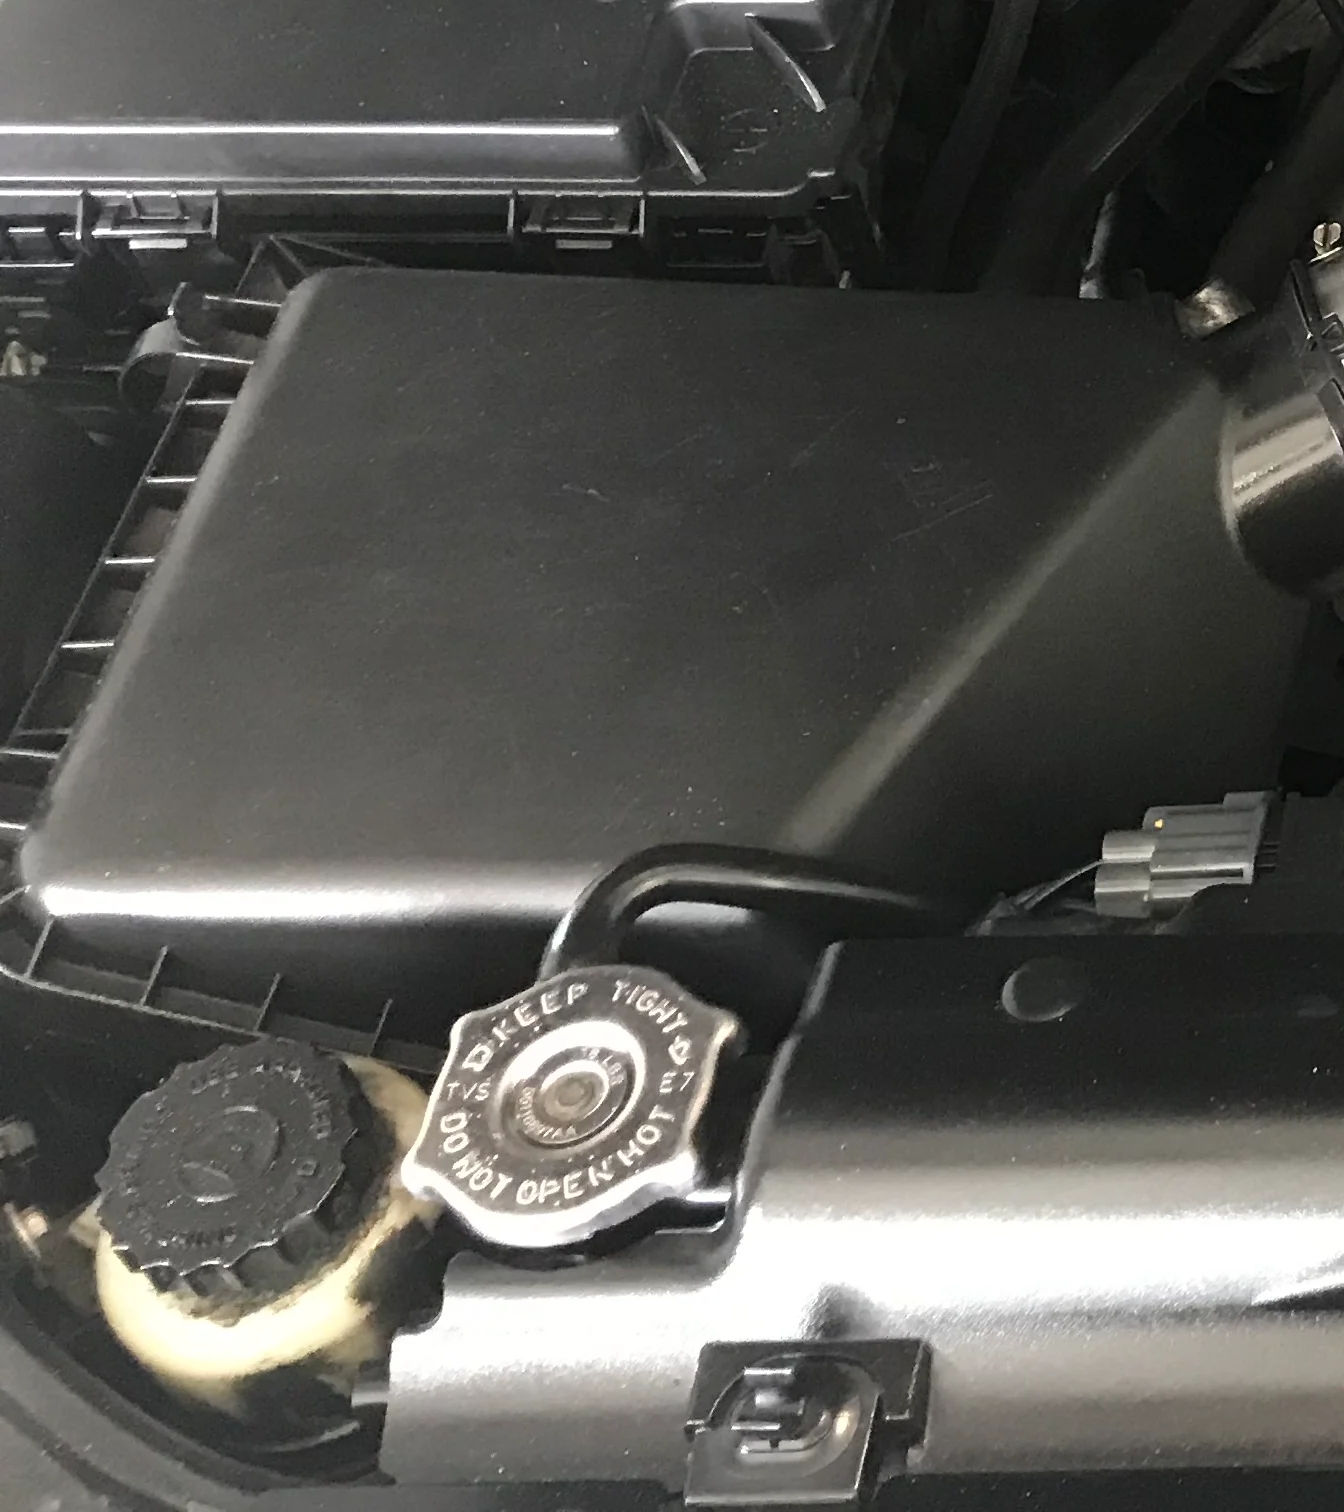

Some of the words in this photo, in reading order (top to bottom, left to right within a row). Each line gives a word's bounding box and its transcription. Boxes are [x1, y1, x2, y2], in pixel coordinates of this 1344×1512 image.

[492, 982, 589, 1042] KEEP
[611, 980, 688, 1035] TIGHT
[446, 1081, 491, 1103] TVS
[439, 1111, 470, 1154] DO
[616, 1104, 676, 1167] HOT
[451, 1148, 513, 1201] NOT
[515, 1162, 614, 1205] OPEN
